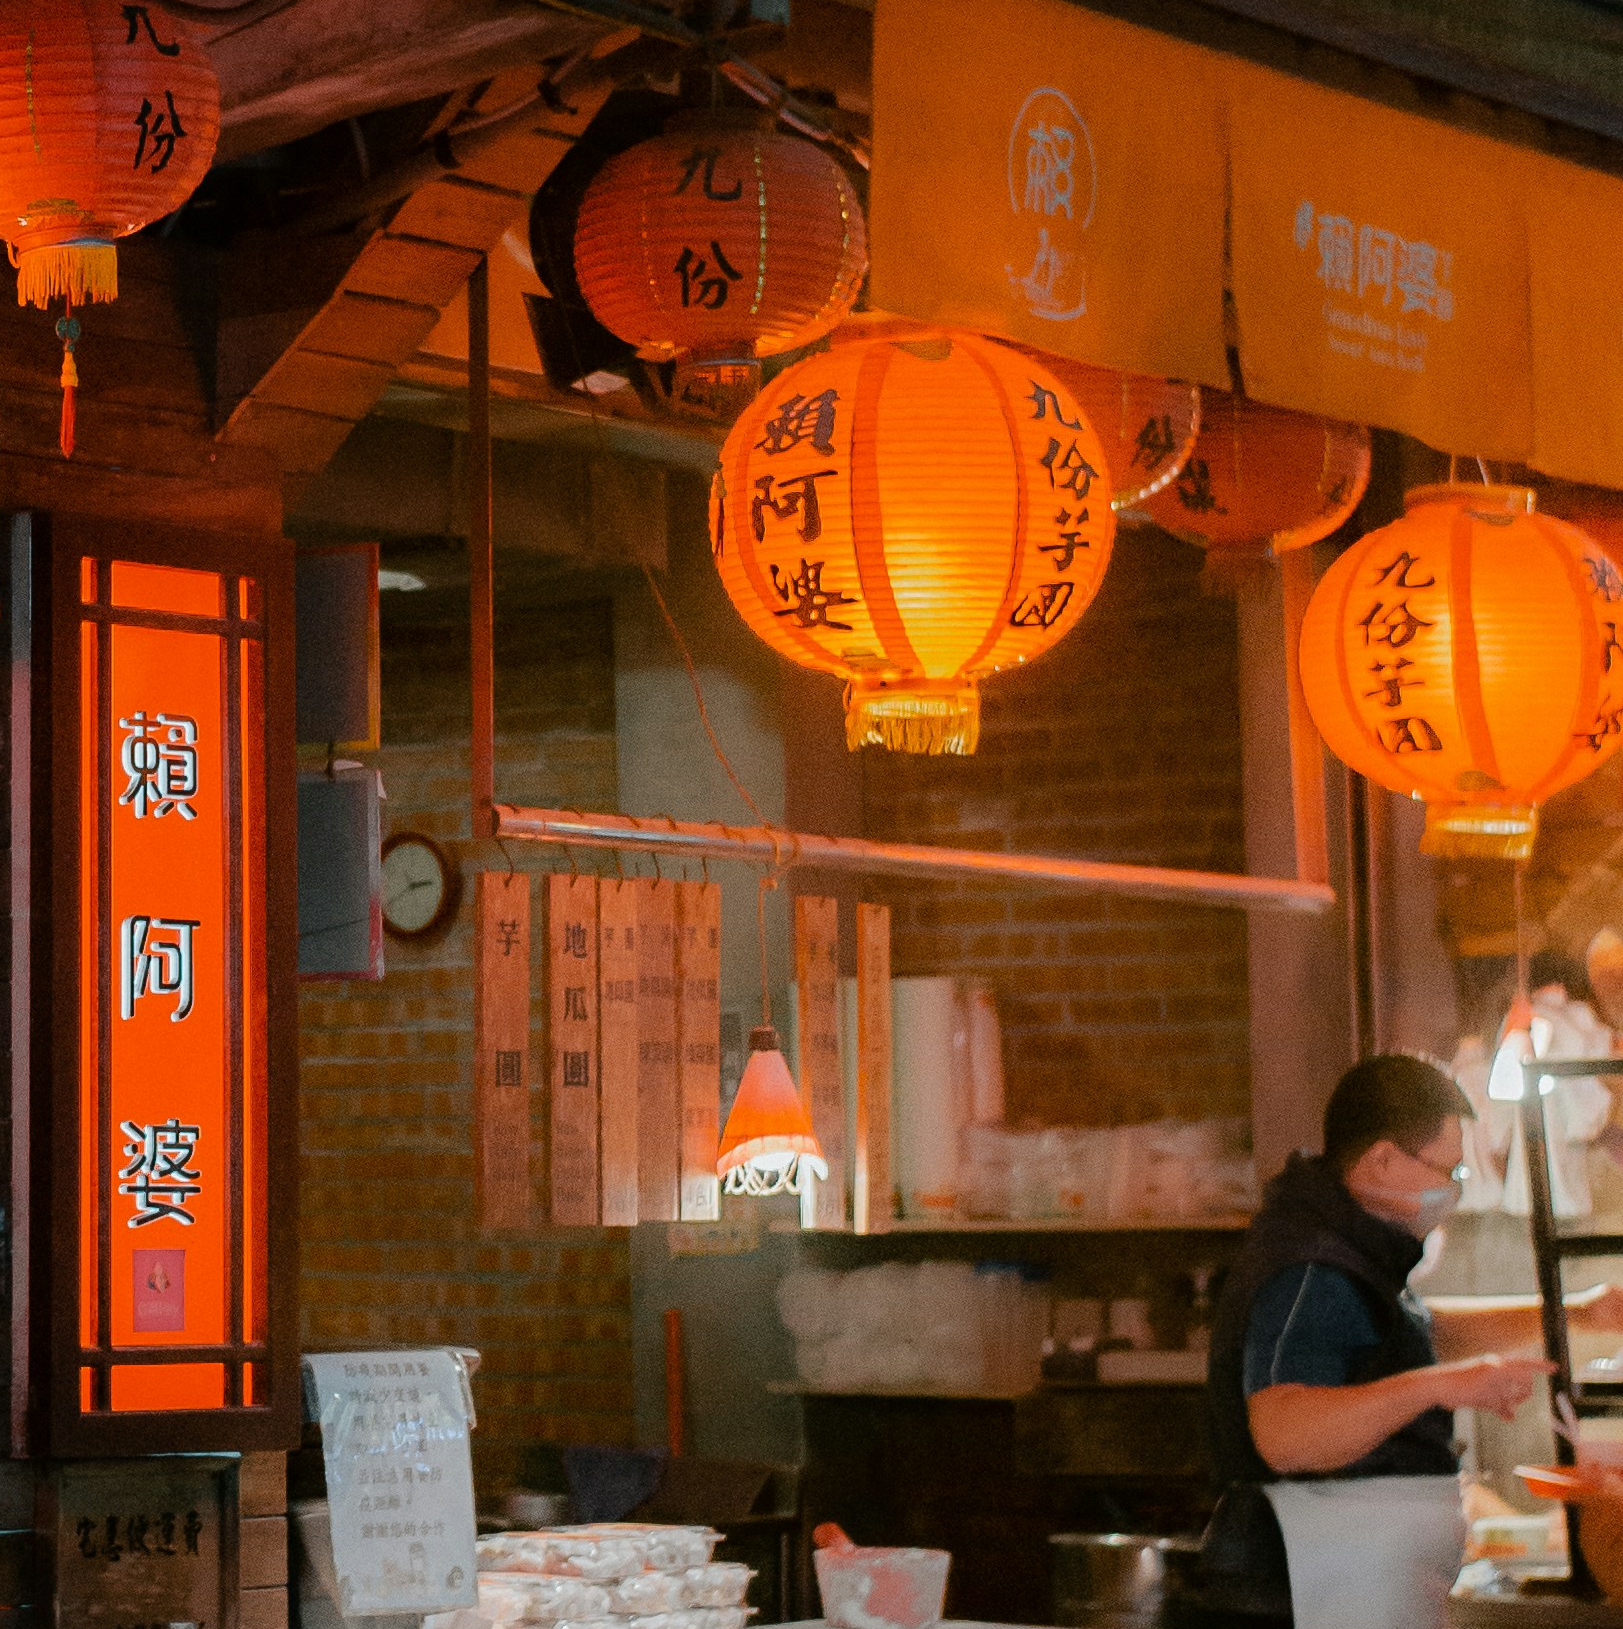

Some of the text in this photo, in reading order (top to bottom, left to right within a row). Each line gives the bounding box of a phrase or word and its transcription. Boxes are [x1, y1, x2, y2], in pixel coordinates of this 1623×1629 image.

[122, 5, 188, 175] 九份
[673, 147, 743, 310] 九份
[752, 388, 858, 631] 賴阿婆
[1009, 378, 1100, 631] 九份芋圓
[1358, 550, 1443, 755] 九份芋圓
[119, 710, 203, 1230] 賴阿婆
[495, 920, 522, 1088] 芋圓
